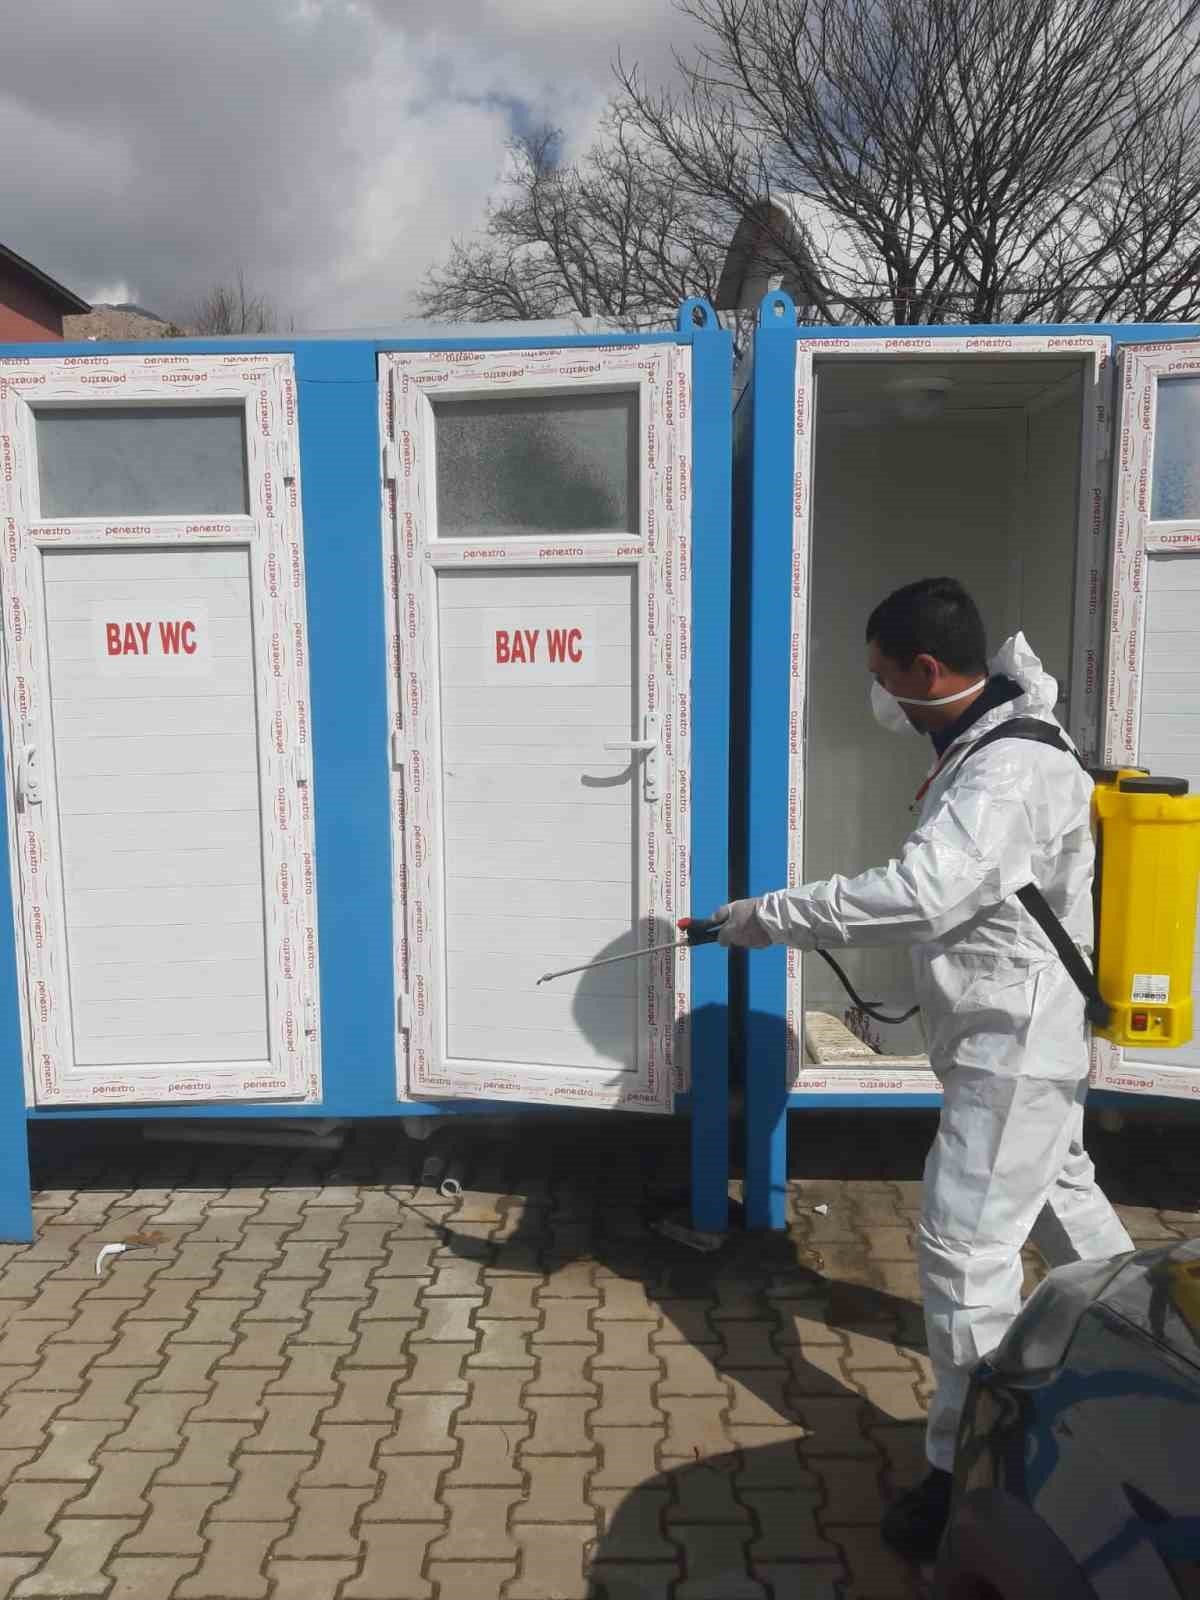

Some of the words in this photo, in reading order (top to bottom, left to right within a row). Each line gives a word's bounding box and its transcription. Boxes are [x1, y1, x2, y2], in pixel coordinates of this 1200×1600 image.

[106, 622, 152, 655] BAY
[159, 621, 197, 654] WC
[496, 630, 540, 663] BAY
[546, 628, 582, 663] WC
